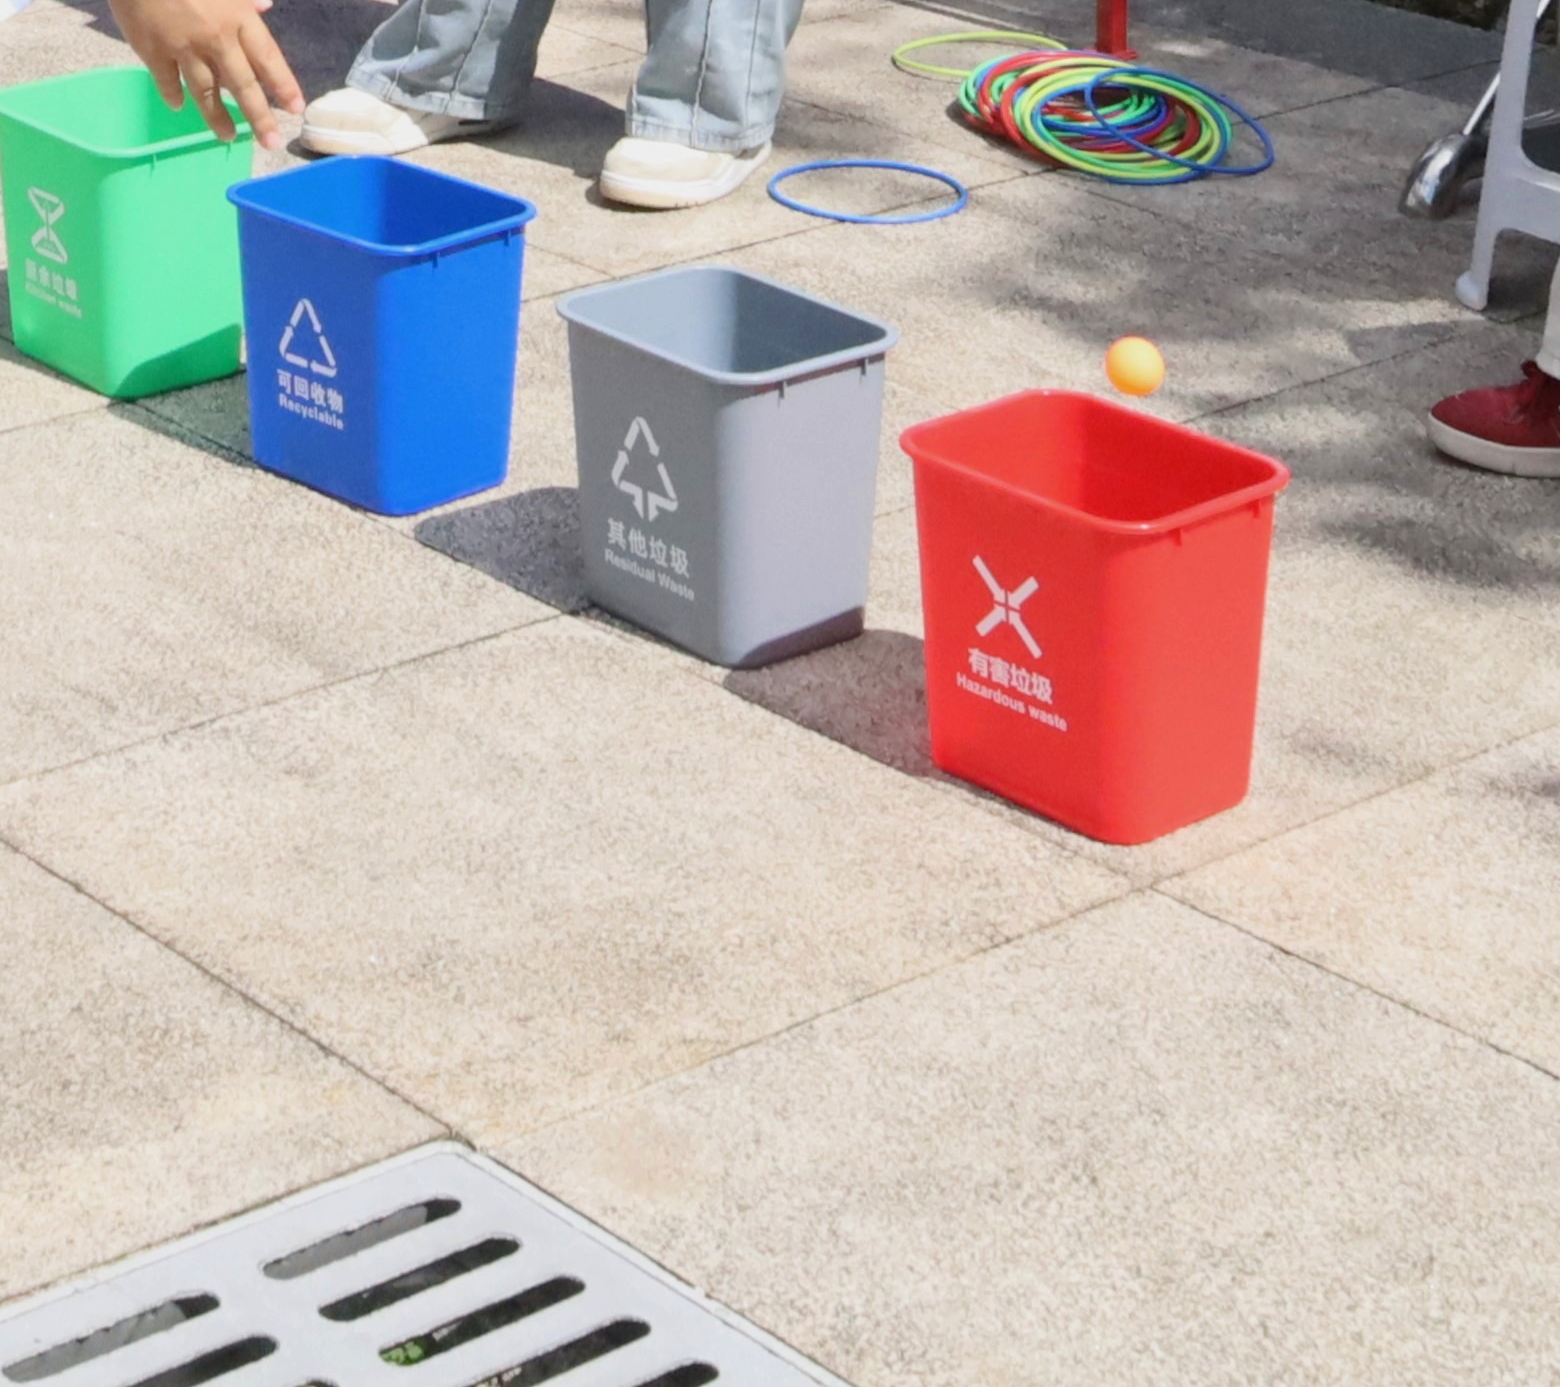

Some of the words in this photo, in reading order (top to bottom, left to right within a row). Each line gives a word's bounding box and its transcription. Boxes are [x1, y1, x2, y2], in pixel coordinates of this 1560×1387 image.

[277, 368, 344, 414] 可回收物
[279, 393, 344, 430] Recyclable
[605, 548, 655, 582] Residual
[607, 517, 690, 579] 其他垃圾
[956, 671, 1026, 715] Hazardous
[1028, 704, 1067, 732] waste
[967, 648, 1053, 705] 有害垃圾
